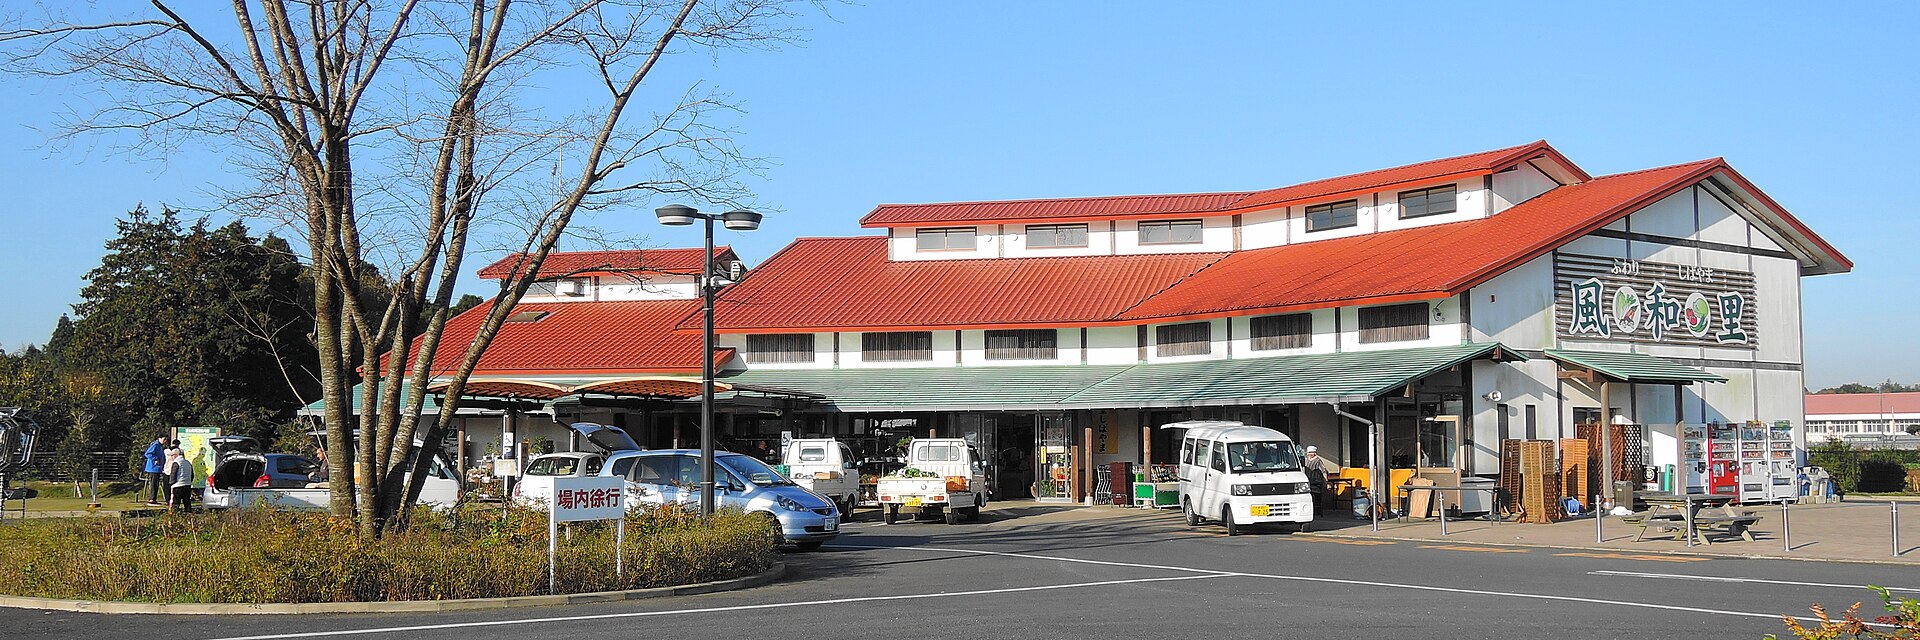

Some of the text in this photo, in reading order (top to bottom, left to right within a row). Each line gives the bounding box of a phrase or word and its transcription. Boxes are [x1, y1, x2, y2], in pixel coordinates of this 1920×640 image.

[1611, 258, 1640, 276] ふわり
[1569, 277, 1748, 344] 風和里
[557, 488, 621, 509] 場内徐行
